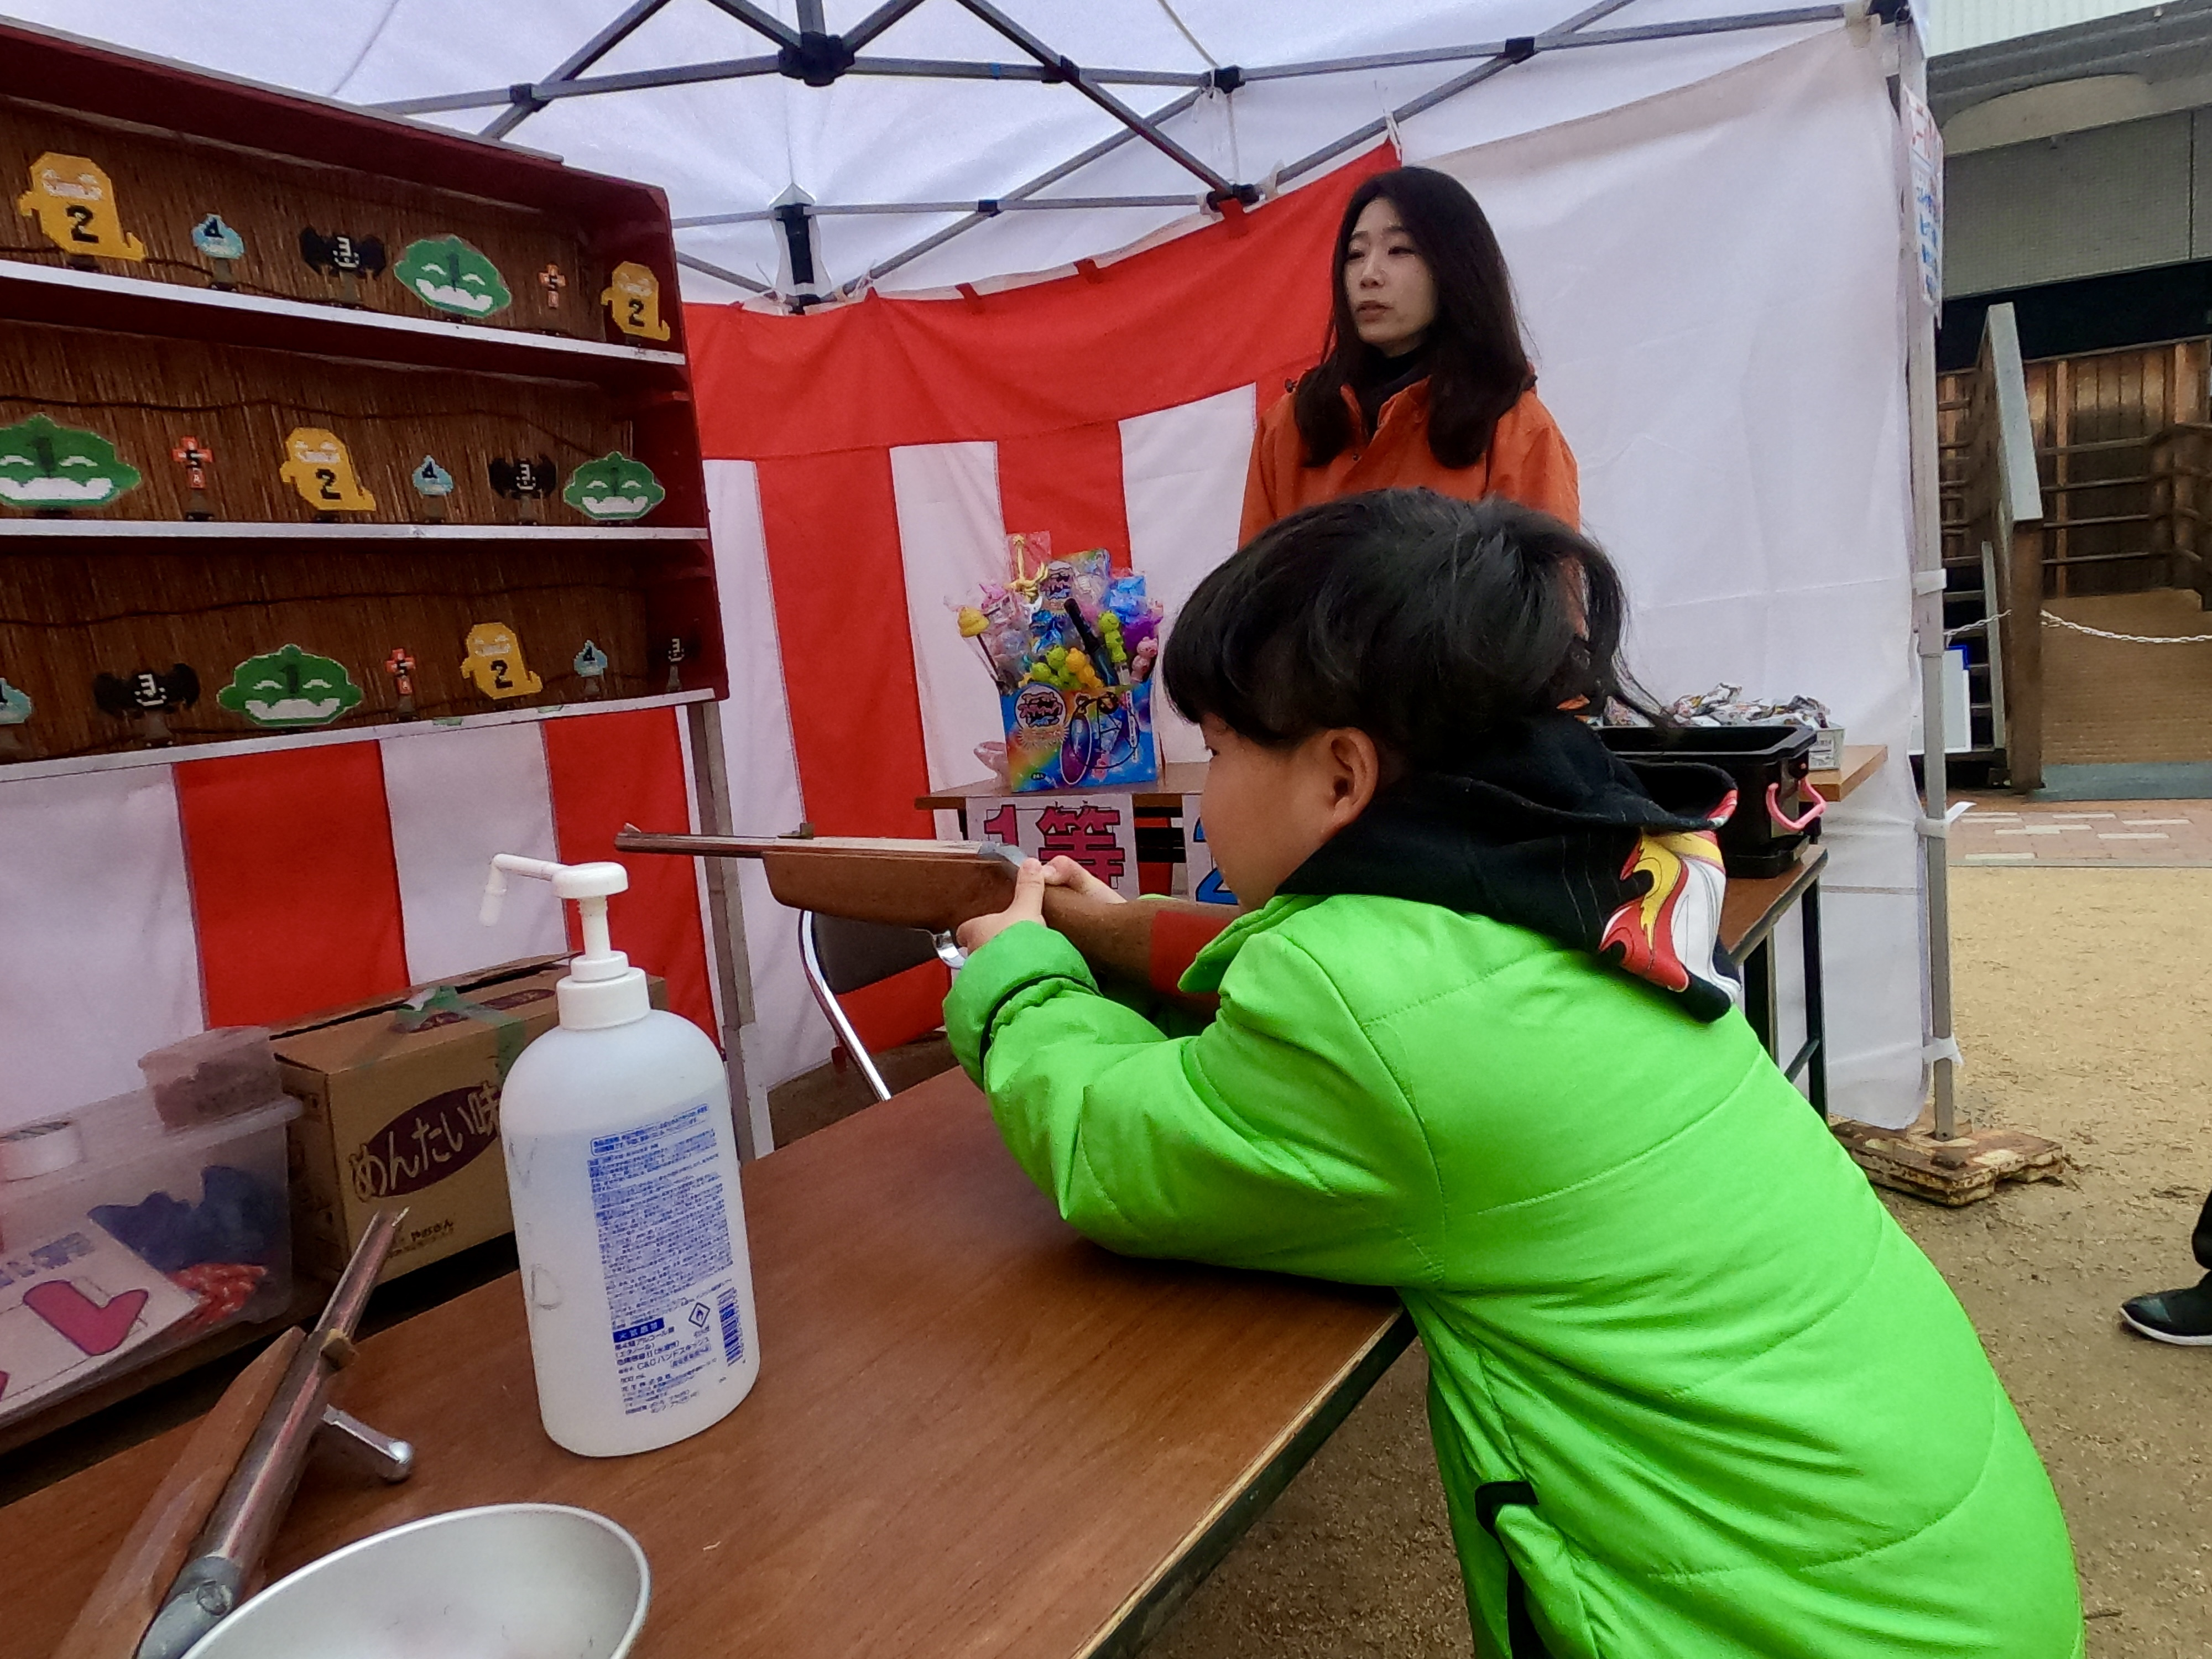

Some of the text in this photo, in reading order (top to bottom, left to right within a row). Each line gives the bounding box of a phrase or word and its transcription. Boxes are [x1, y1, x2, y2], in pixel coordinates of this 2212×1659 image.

[65, 205, 99, 243] 2
[205, 216, 225, 239] 4
[628, 298, 645, 327] 2
[315, 468, 341, 500] 2
[421, 461, 438, 479] 4
[582, 646, 596, 662] 4
[490, 659, 513, 689] 2
[984, 804, 1125, 889] 1等
[349, 1081, 501, 1203] めんたい味
